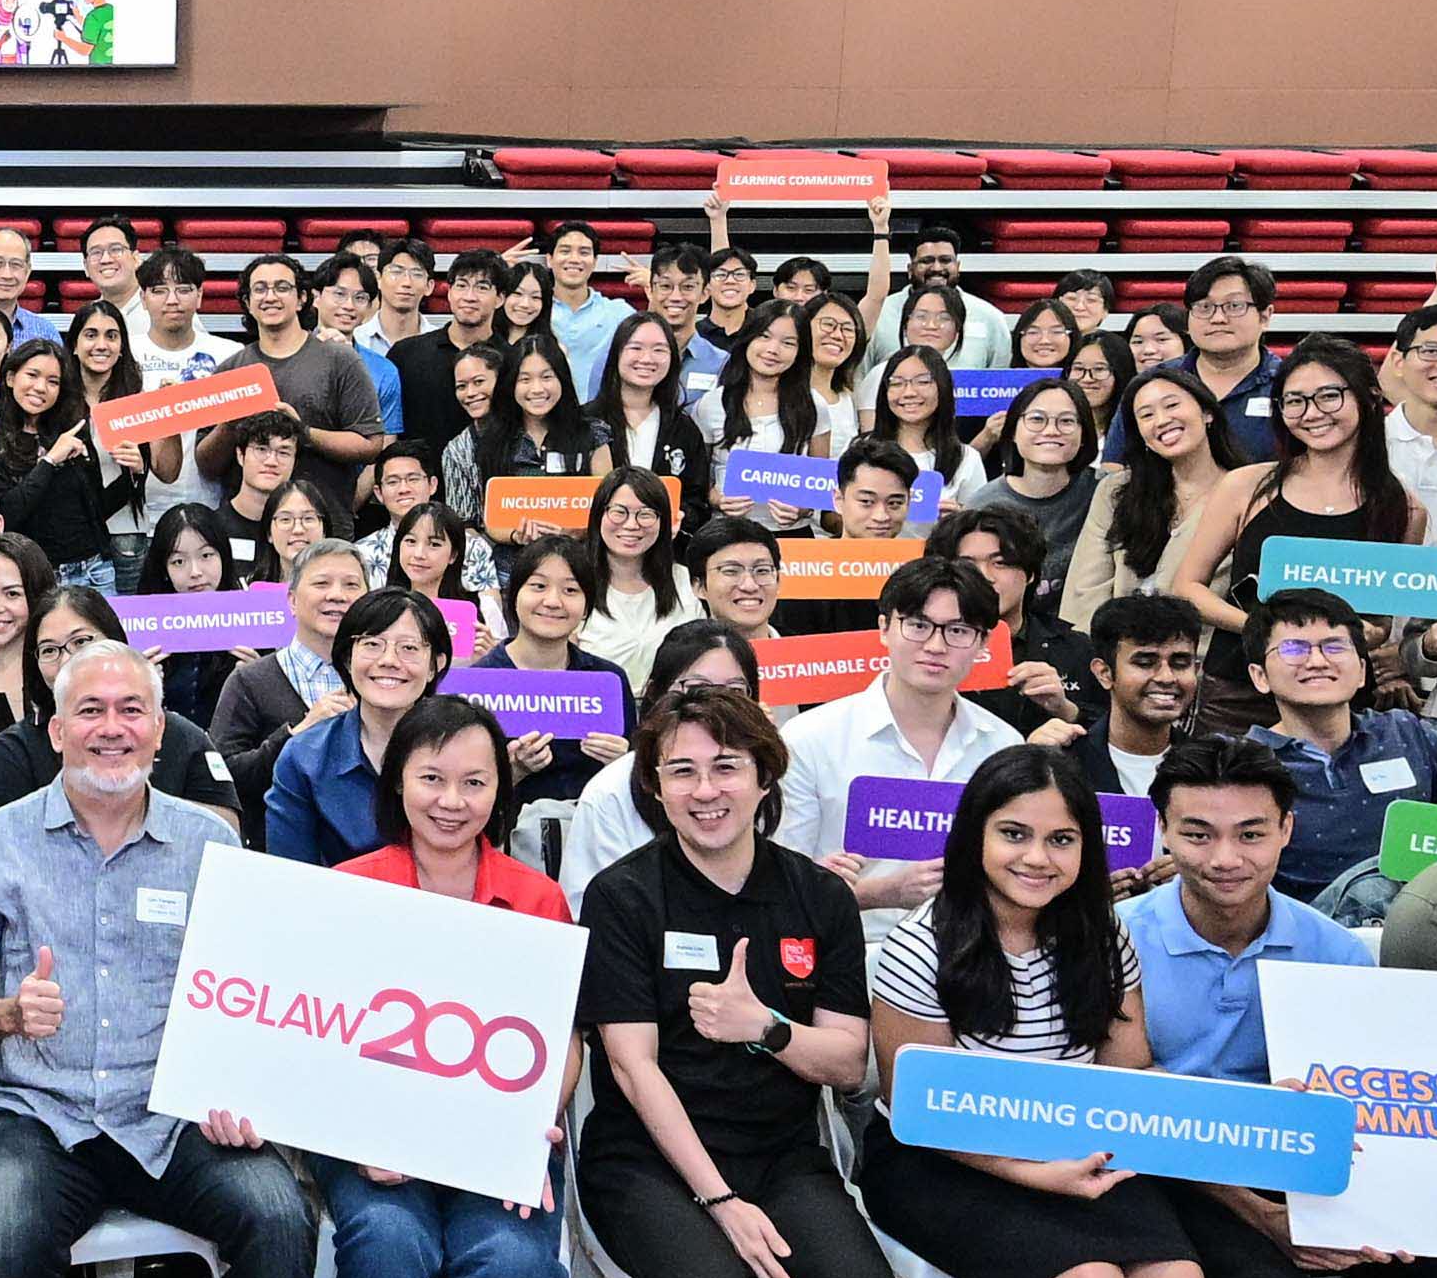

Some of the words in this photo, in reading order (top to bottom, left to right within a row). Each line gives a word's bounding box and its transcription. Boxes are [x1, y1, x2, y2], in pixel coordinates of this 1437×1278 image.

[729, 175, 785, 186] LEARNING
[788, 175, 874, 186] COMMUNITIES
[109, 405, 173, 431] INCLUSIVE
[174, 383, 263, 414] COMMUNITIES
[741, 468, 801, 488] CARING
[501, 496, 568, 510] INCLUSIVE
[779, 561, 834, 577] ARING
[1283, 563, 1386, 588] HEALTHY
[162, 611, 285, 631] COMMUNITIES
[757, 658, 865, 680] SUSTAINABLE
[868, 807, 953, 832] HEALTH
[926, 1089, 1077, 1127] LEARNING
[1085, 1107, 1317, 1155] COMMUNITIES
